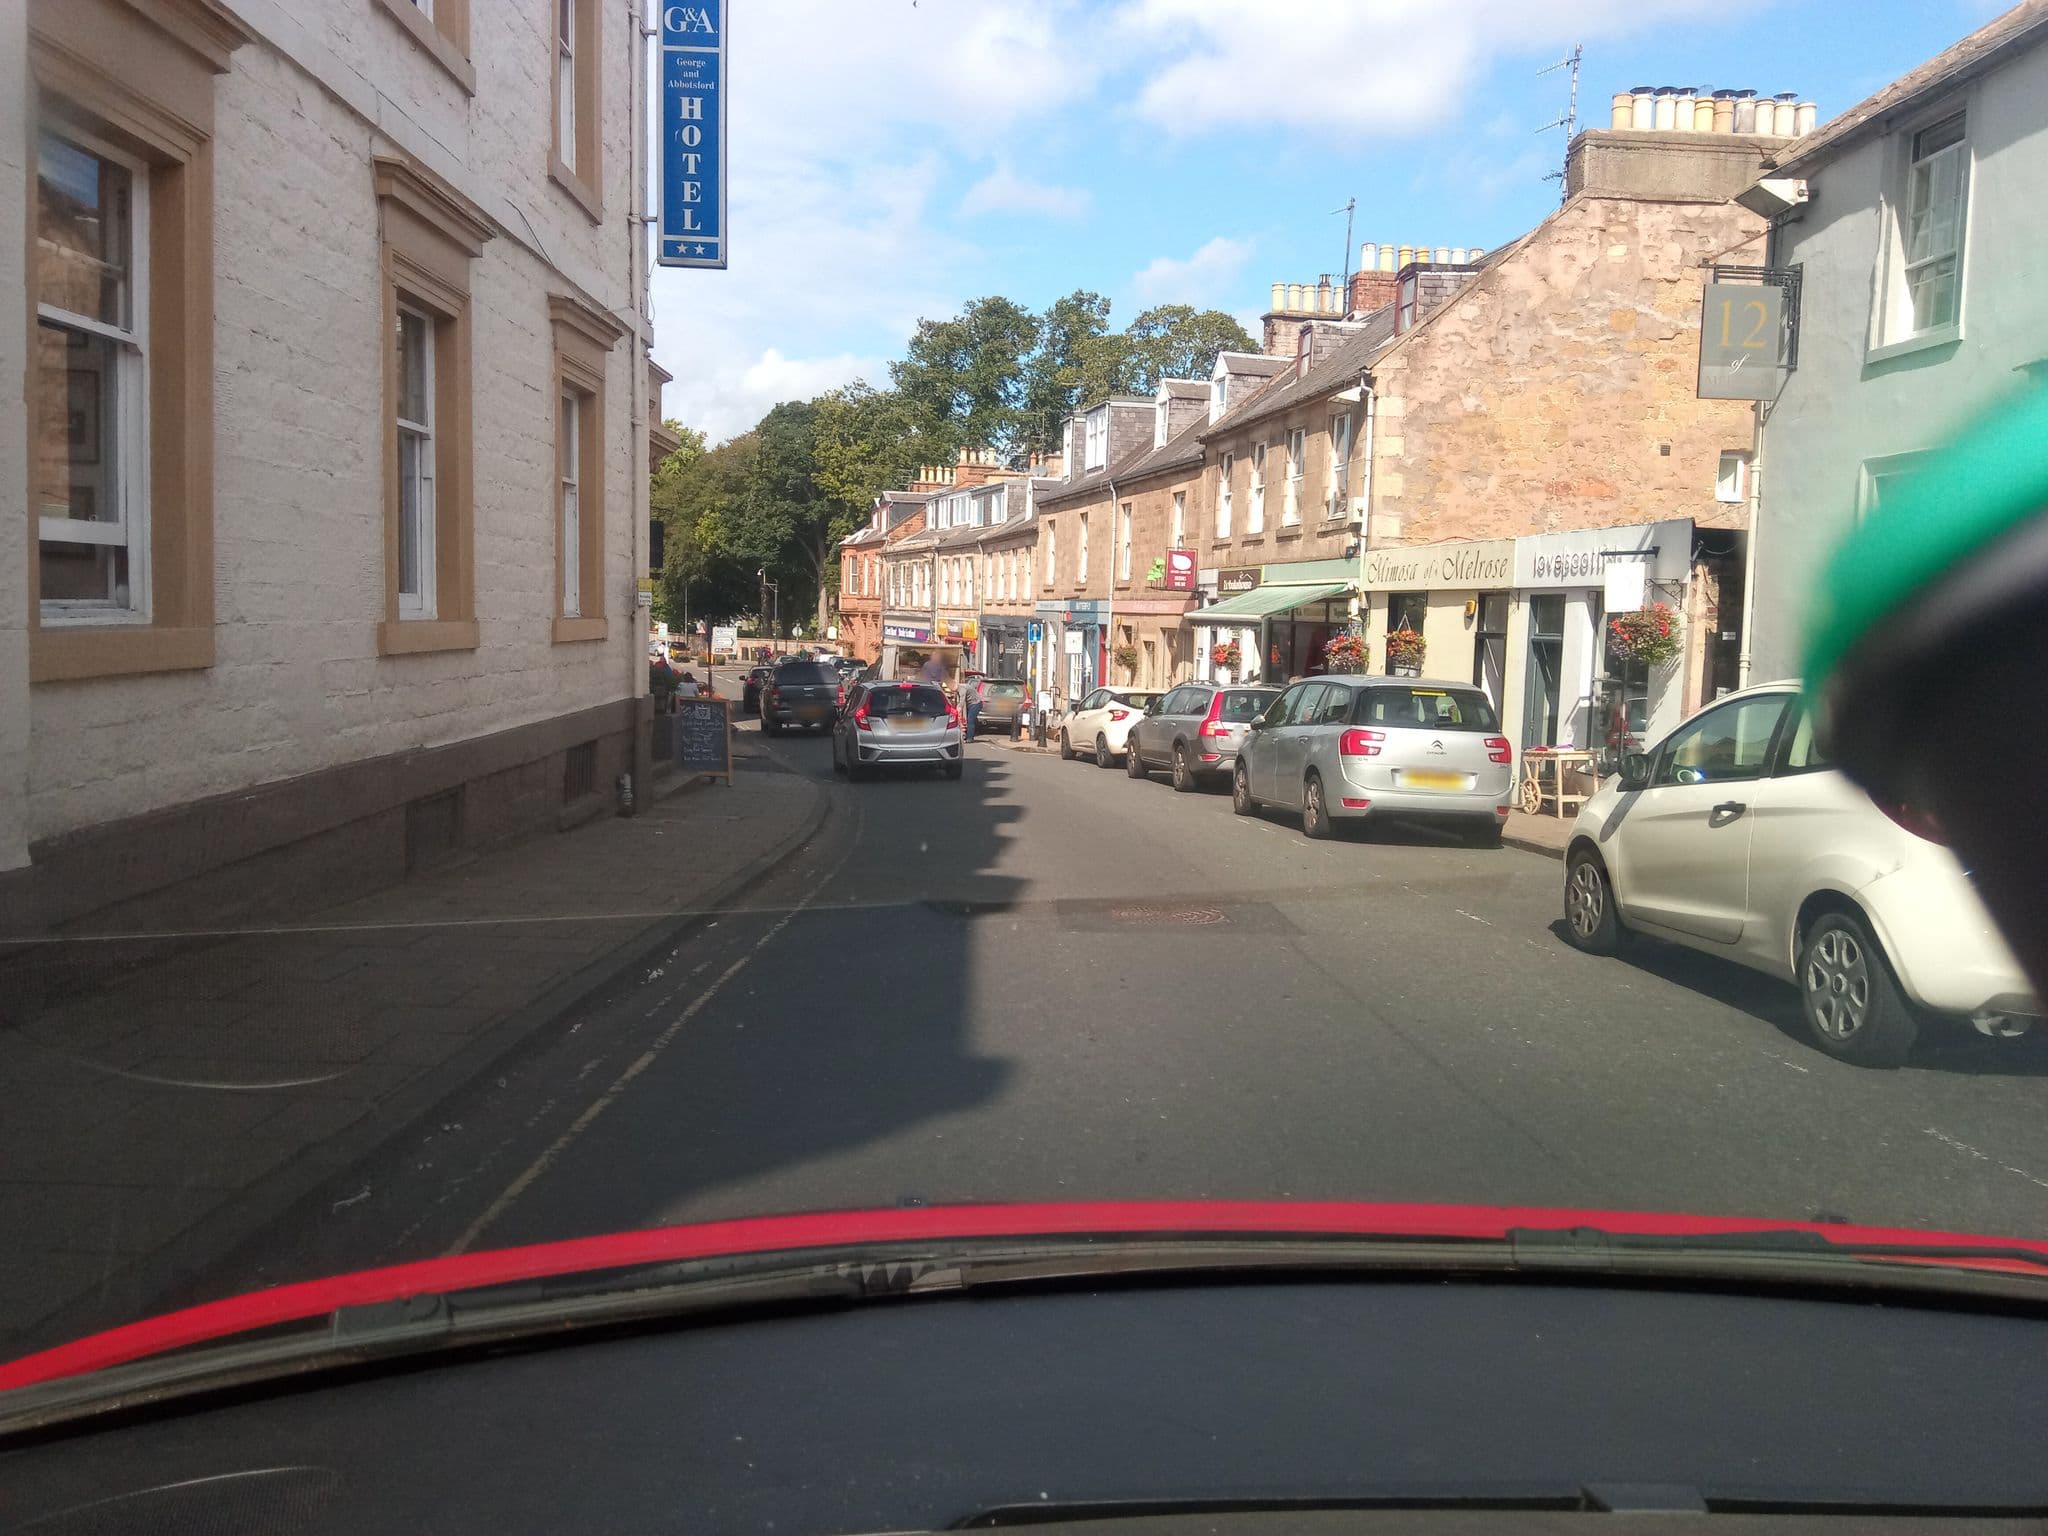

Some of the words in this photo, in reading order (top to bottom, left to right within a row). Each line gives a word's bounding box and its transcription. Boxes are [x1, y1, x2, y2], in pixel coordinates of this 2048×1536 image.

[676, 57, 706, 68] George
[667, 79, 715, 90] Abbotsford
[683, 70, 700, 79] and
[679, 97, 704, 231] HOTEL
[1719, 299, 1768, 348] 12
[1729, 352, 1750, 375] of
[1367, 553, 1418, 583] Mimosa
[1442, 549, 1508, 581] Melrose
